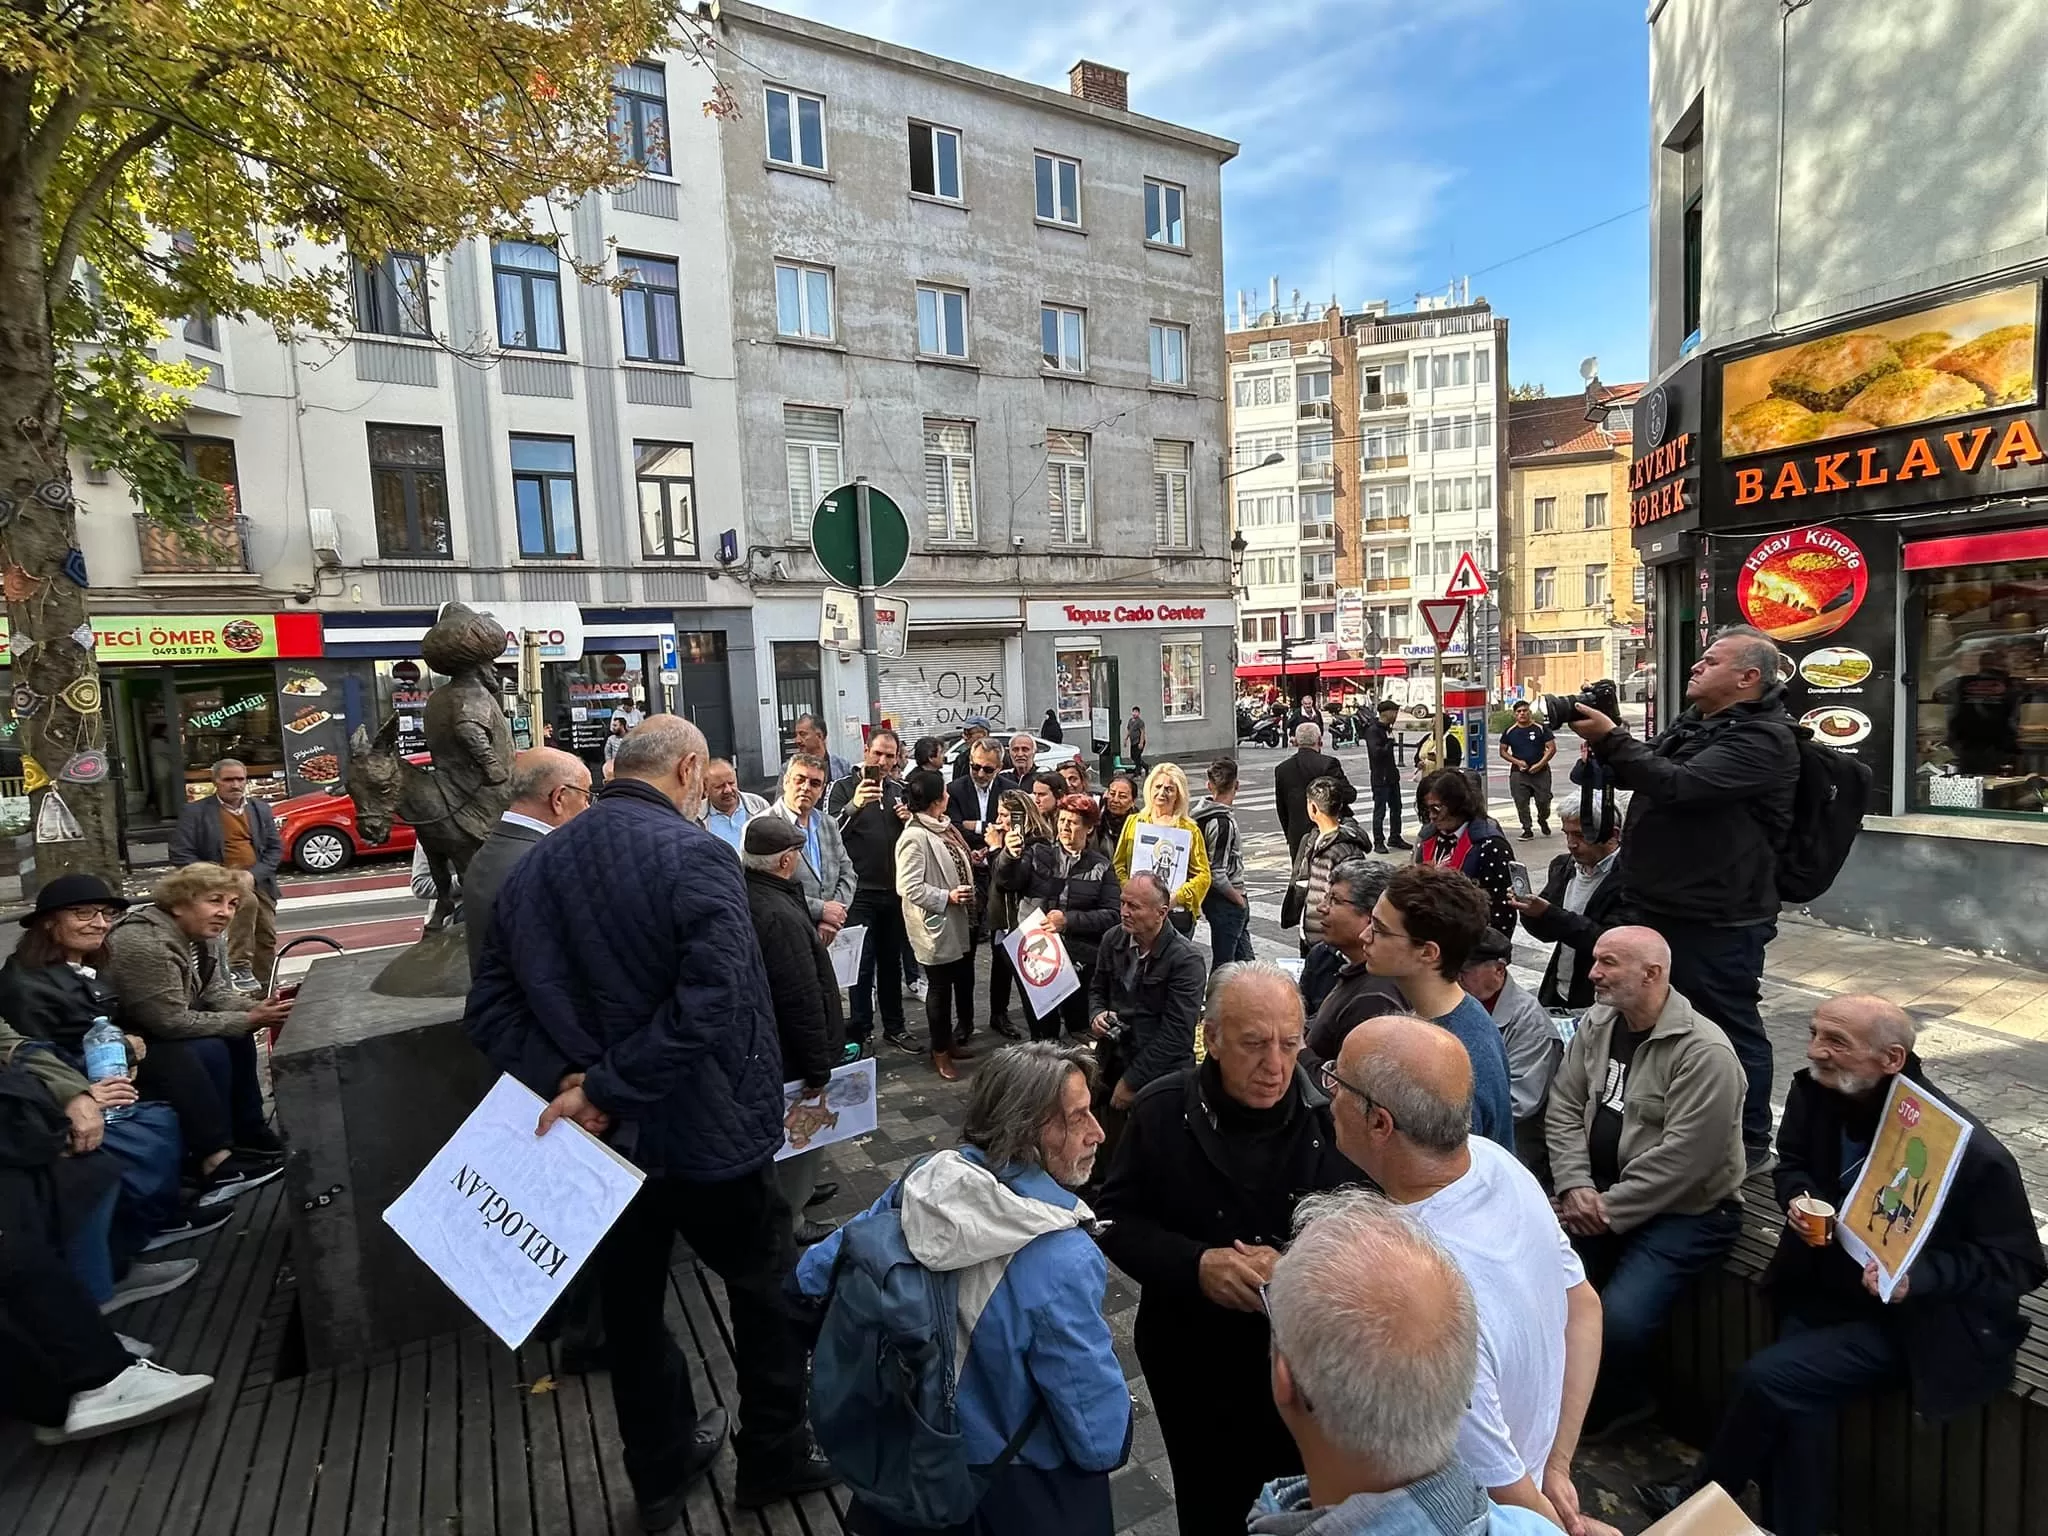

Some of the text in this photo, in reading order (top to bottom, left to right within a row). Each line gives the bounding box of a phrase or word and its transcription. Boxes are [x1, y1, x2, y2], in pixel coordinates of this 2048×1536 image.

[1628, 433, 1689, 492] LEVENT
[1735, 419, 2042, 505] BAKLAVA
[1745, 530, 1860, 571] Hatay Künefe
[1063, 604, 1206, 625] Topuz Cado Center
[149, 627, 216, 646] ÖMER
[663, 638, 674, 665] P
[1402, 646, 1435, 655] TURKIS
[188, 692, 266, 729] Vegetarian
[1898, 1100, 1920, 1124] STOP
[450, 1163, 569, 1280] KELOĞLAN
